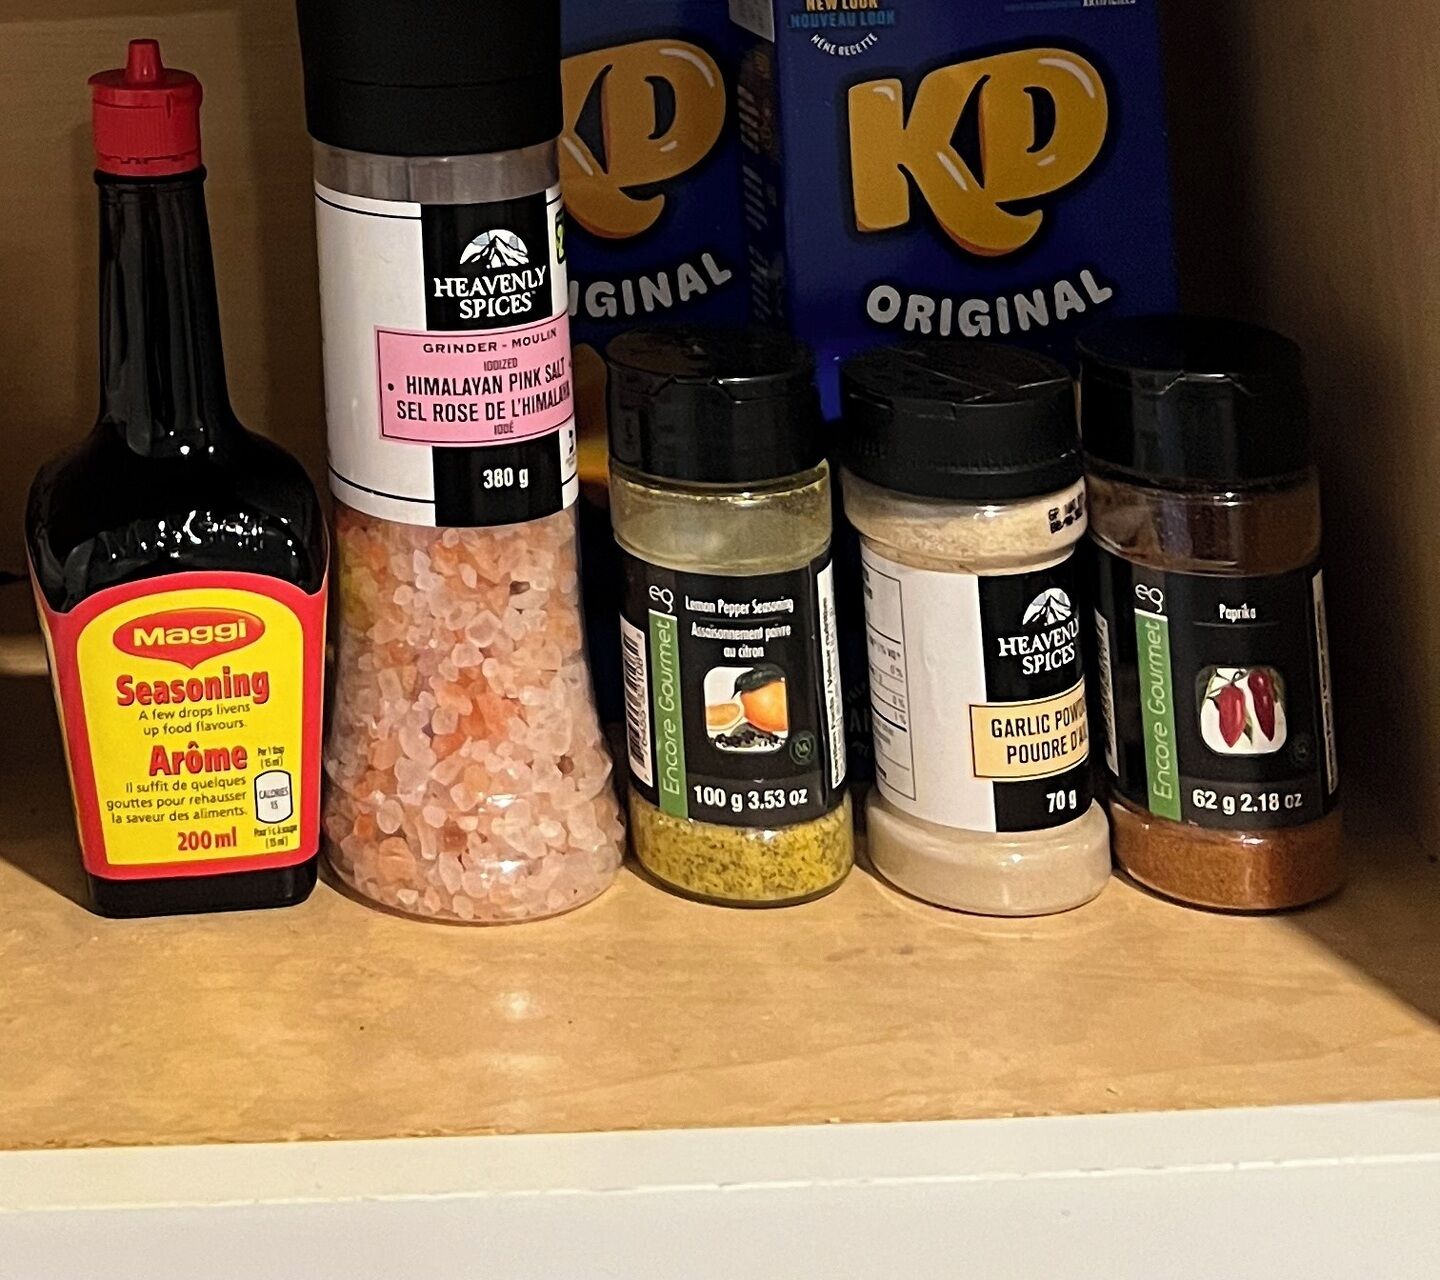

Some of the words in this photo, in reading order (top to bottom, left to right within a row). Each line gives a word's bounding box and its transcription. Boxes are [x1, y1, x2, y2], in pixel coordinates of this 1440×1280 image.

[789, 11, 857, 30] NOUVEAU
[858, 9, 896, 27] LOOK
[847, 47, 1110, 257] KD
[433, 264, 547, 298] HEAVENLY
[866, 268, 1114, 338] ORIGINAL
[422, 339, 498, 355] GRINDER
[511, 326, 559, 350] MOULIN
[406, 373, 503, 397] HIMALAYAN
[508, 367, 543, 394] PINK
[544, 356, 566, 388] SALT
[396, 398, 428, 423] SEL
[432, 399, 480, 424] ROSE
[485, 398, 507, 422] DE
[482, 467, 514, 490] 380
[518, 470, 529, 490] g
[717, 598, 751, 618] Pepper
[751, 595, 795, 615] Seasoning
[1218, 602, 1257, 624] Paprika
[133, 617, 248, 648] Maggi
[723, 645, 737, 658] au
[738, 643, 765, 659] citron
[1021, 642, 1076, 676] SPICES
[655, 619, 677, 714] Gourmet
[1146, 620, 1168, 717] Gourmet
[115, 666, 270, 706] Seasoning
[138, 710, 149, 721] A
[151, 708, 175, 721] few
[177, 704, 214, 721] drops
[216, 702, 251, 716] livens
[143, 724, 160, 738] up
[162, 721, 192, 735] food
[991, 713, 1050, 739] GARLIC
[148, 740, 249, 777] Arôme
[661, 717, 681, 796] Encore
[1006, 735, 1069, 765] POUDRE
[1152, 721, 1173, 800] Encore
[136, 781, 169, 794] suffit
[172, 779, 188, 792] de
[190, 775, 247, 791] quelques
[693, 784, 726, 808] 100
[730, 793, 743, 813] g
[747, 789, 786, 811] 3.53
[788, 788, 809, 806] oz
[106, 795, 153, 811] gouttes
[156, 796, 186, 811] pour
[188, 790, 247, 805] rehausser
[1046, 790, 1066, 814] 70
[1068, 790, 1077, 811] g
[1192, 789, 1218, 810] 62
[1222, 796, 1237, 816] g
[1240, 792, 1280, 814] 2.18
[1283, 792, 1304, 809] oz
[111, 812, 123, 824] la
[125, 810, 166, 824] saveur
[168, 808, 190, 822] des
[177, 831, 212, 851] 200
[214, 826, 238, 849] ml
